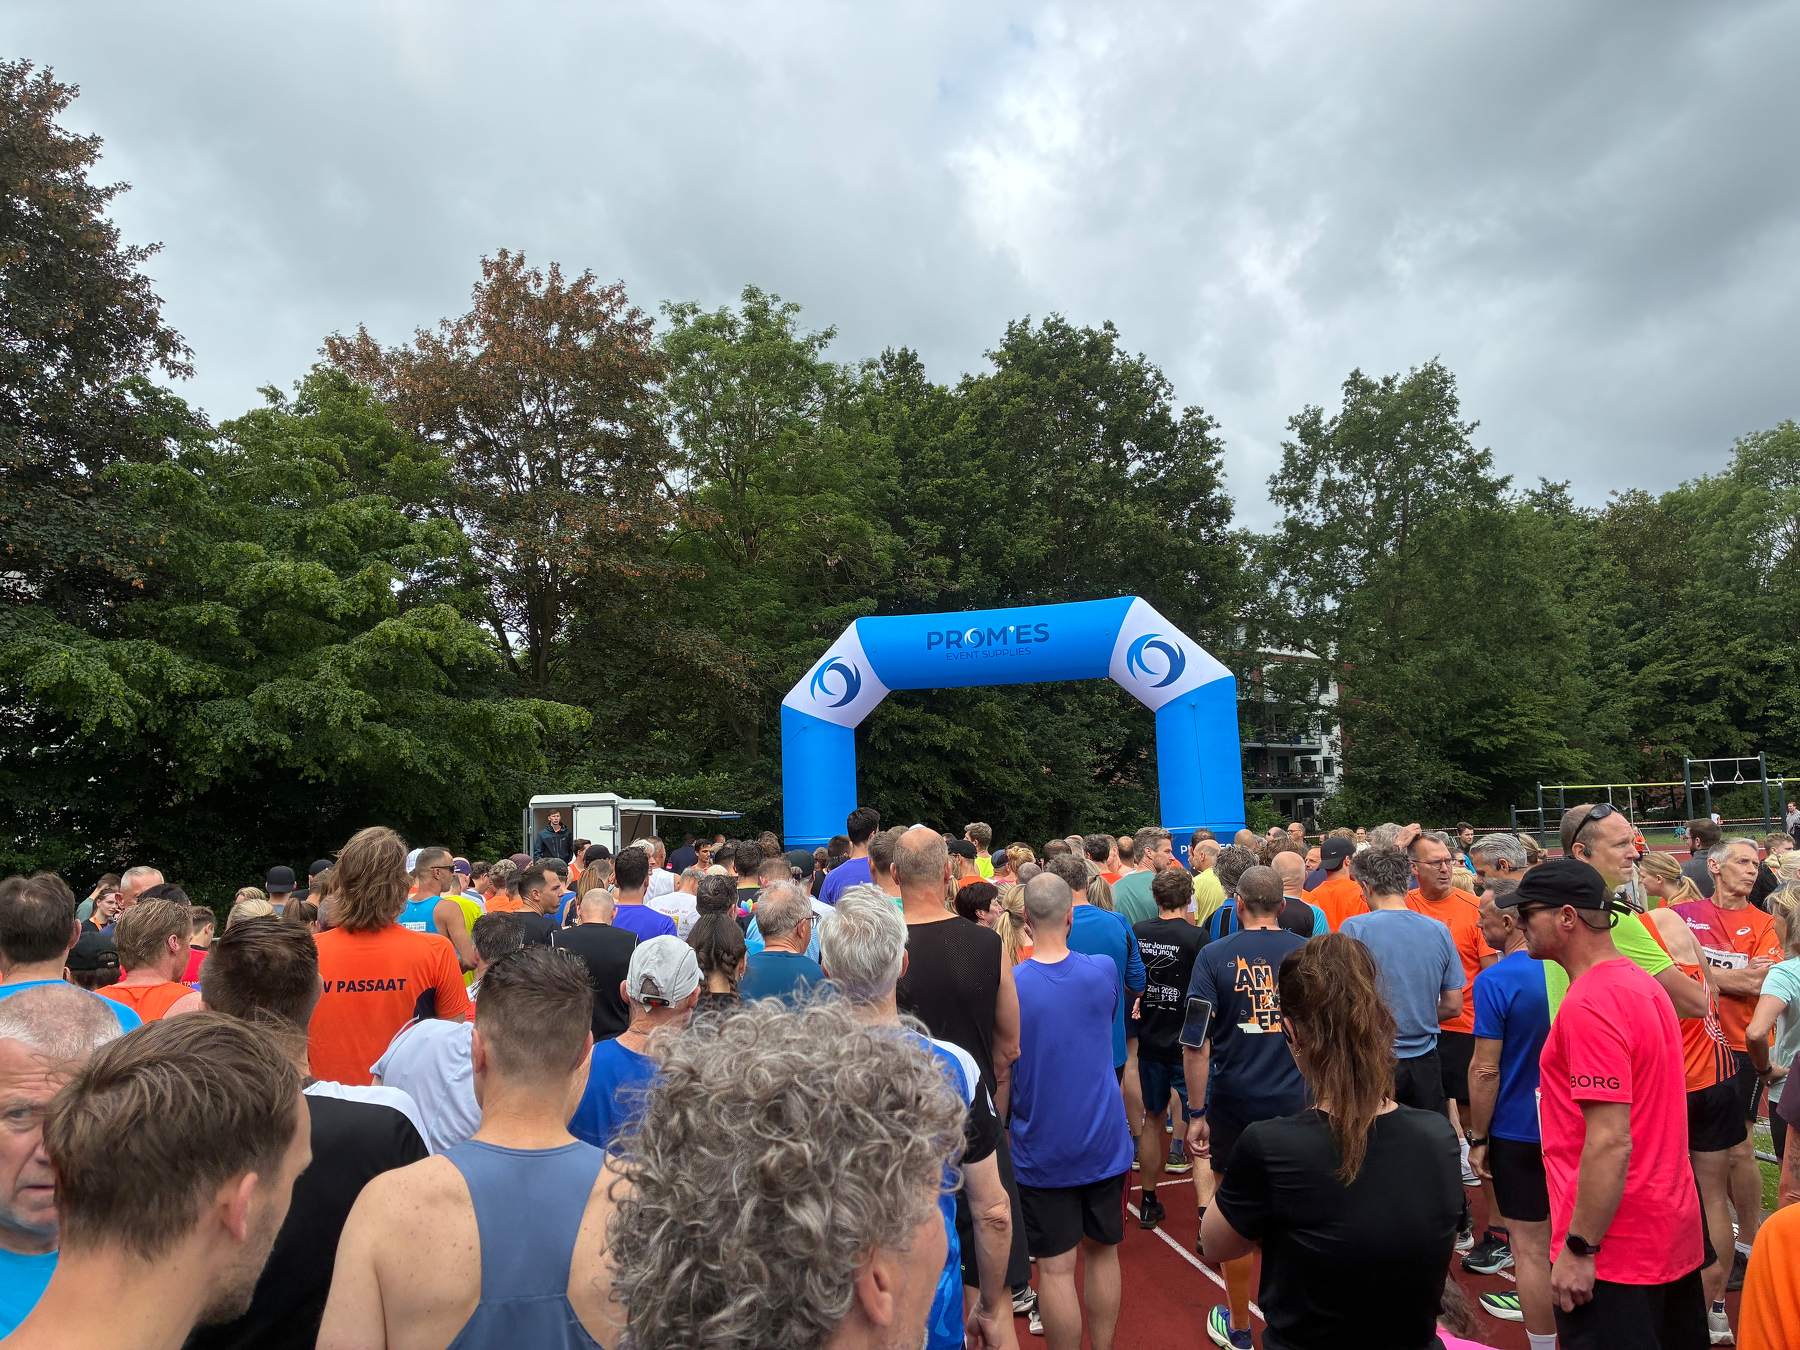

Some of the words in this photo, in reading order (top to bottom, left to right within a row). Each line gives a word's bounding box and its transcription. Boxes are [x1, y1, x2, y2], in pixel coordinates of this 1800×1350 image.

[927, 623, 1049, 650] PROM'ES
[947, 651, 979, 660] EVENT
[982, 647, 1031, 658] SUPPLIES
[336, 978, 407, 993] PASSAAT
[1571, 1075, 1619, 1089] BORG
